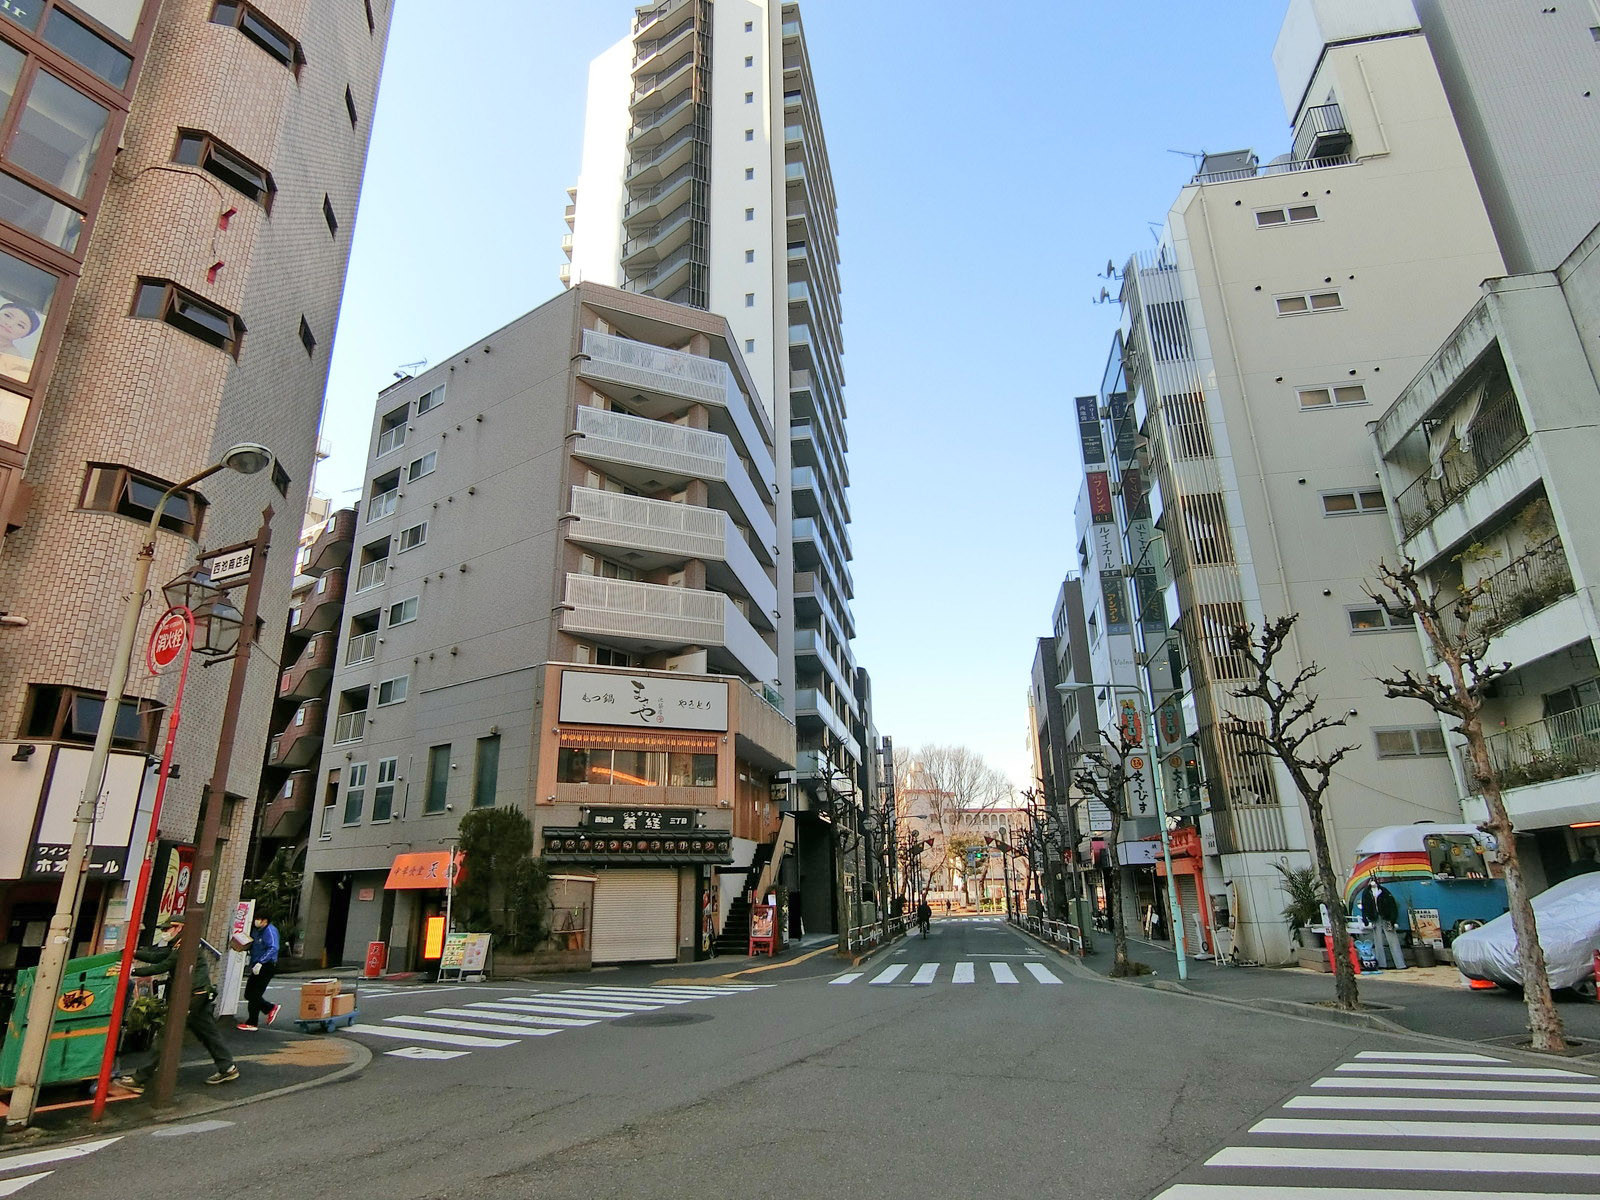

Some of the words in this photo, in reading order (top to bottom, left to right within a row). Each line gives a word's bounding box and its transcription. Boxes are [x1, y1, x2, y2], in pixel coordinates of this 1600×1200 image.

[1093, 480, 1106, 513] フレンズ
[156, 628, 183, 653] 消火栓
[582, 692, 615, 704] もつ鍋
[35, 858, 119, 874] ホオール
